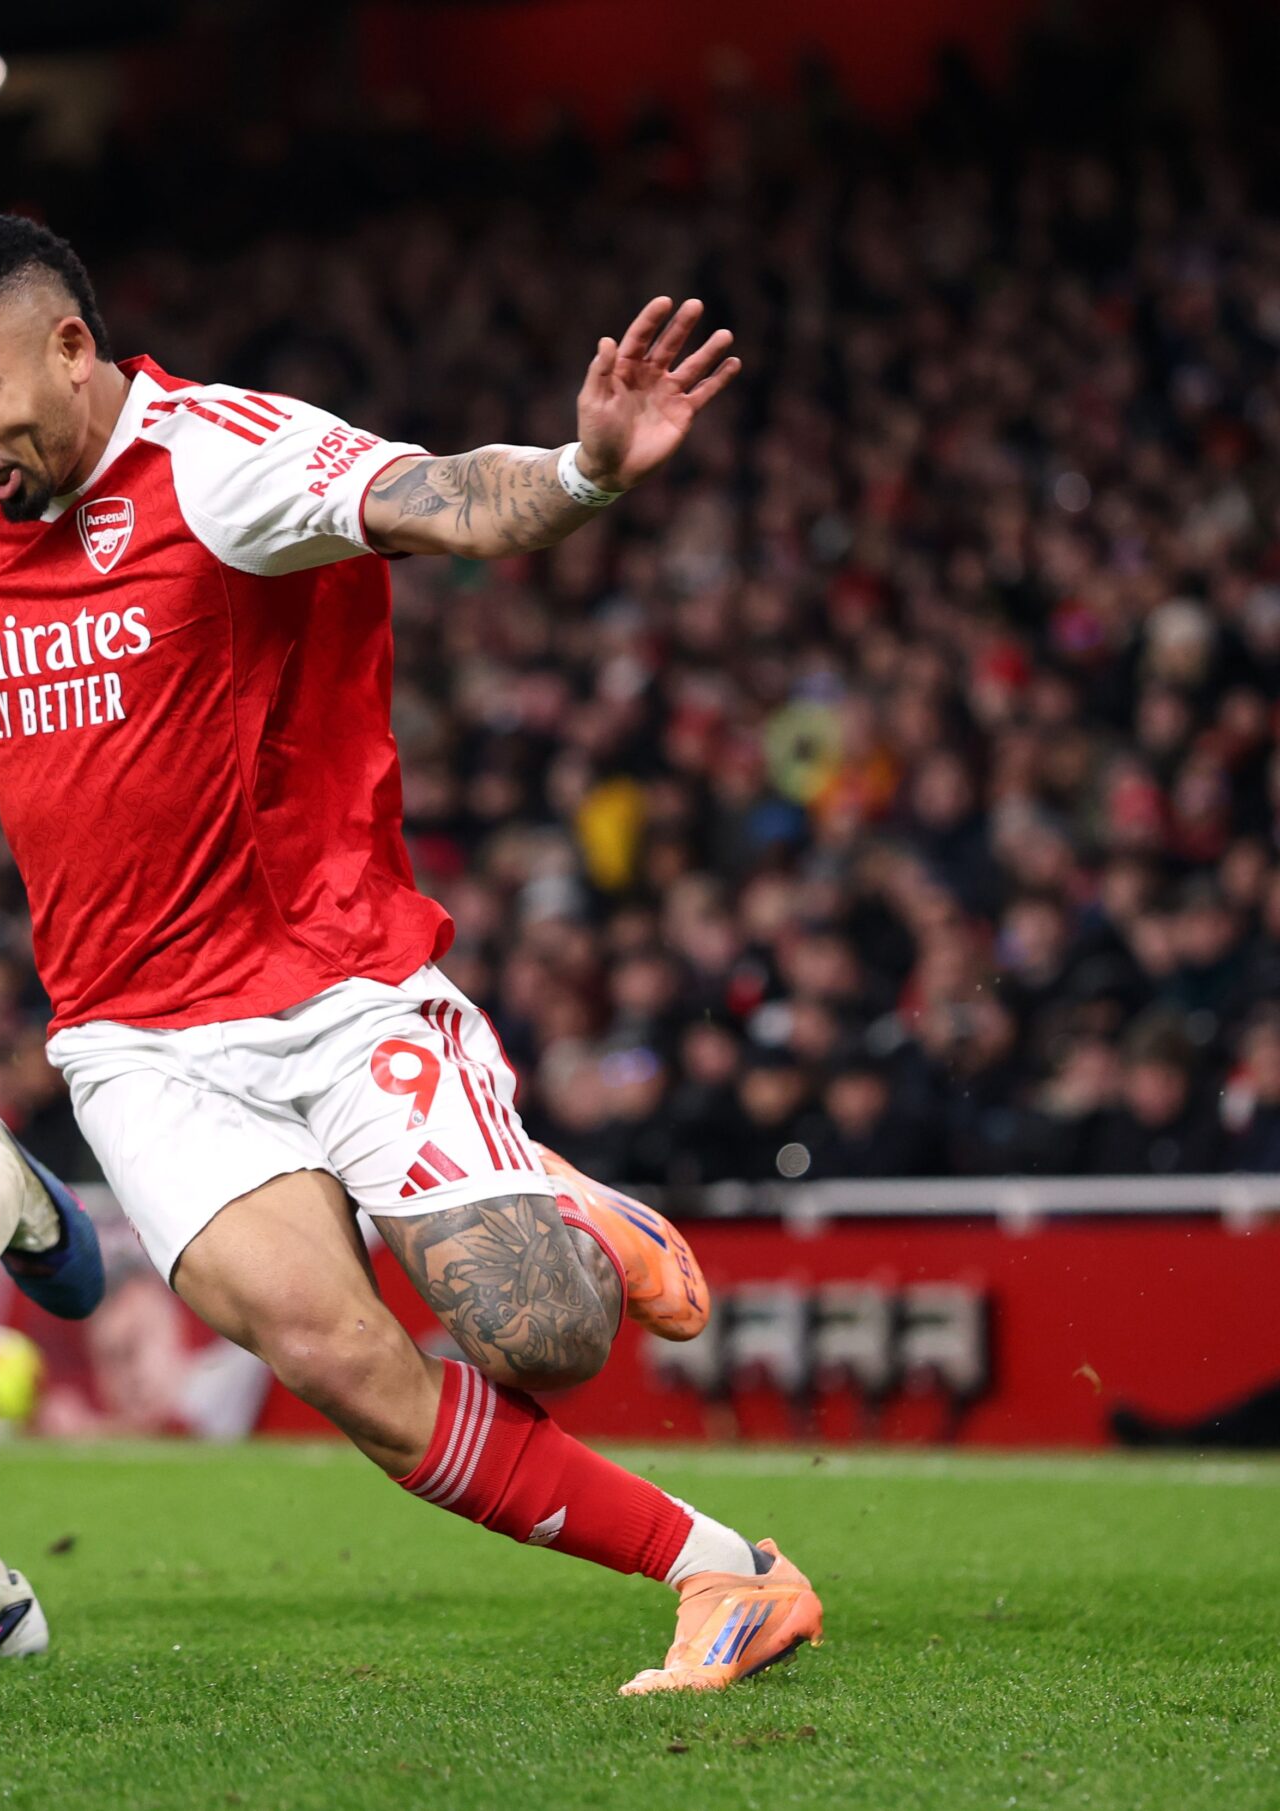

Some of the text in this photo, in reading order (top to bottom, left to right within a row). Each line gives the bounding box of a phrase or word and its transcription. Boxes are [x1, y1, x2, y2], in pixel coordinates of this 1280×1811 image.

[305, 426, 355, 470] VISIT
[86, 509, 128, 526] Arsenal
[18, 672, 126, 736] BETTER
[371, 1039, 441, 1131] 9
